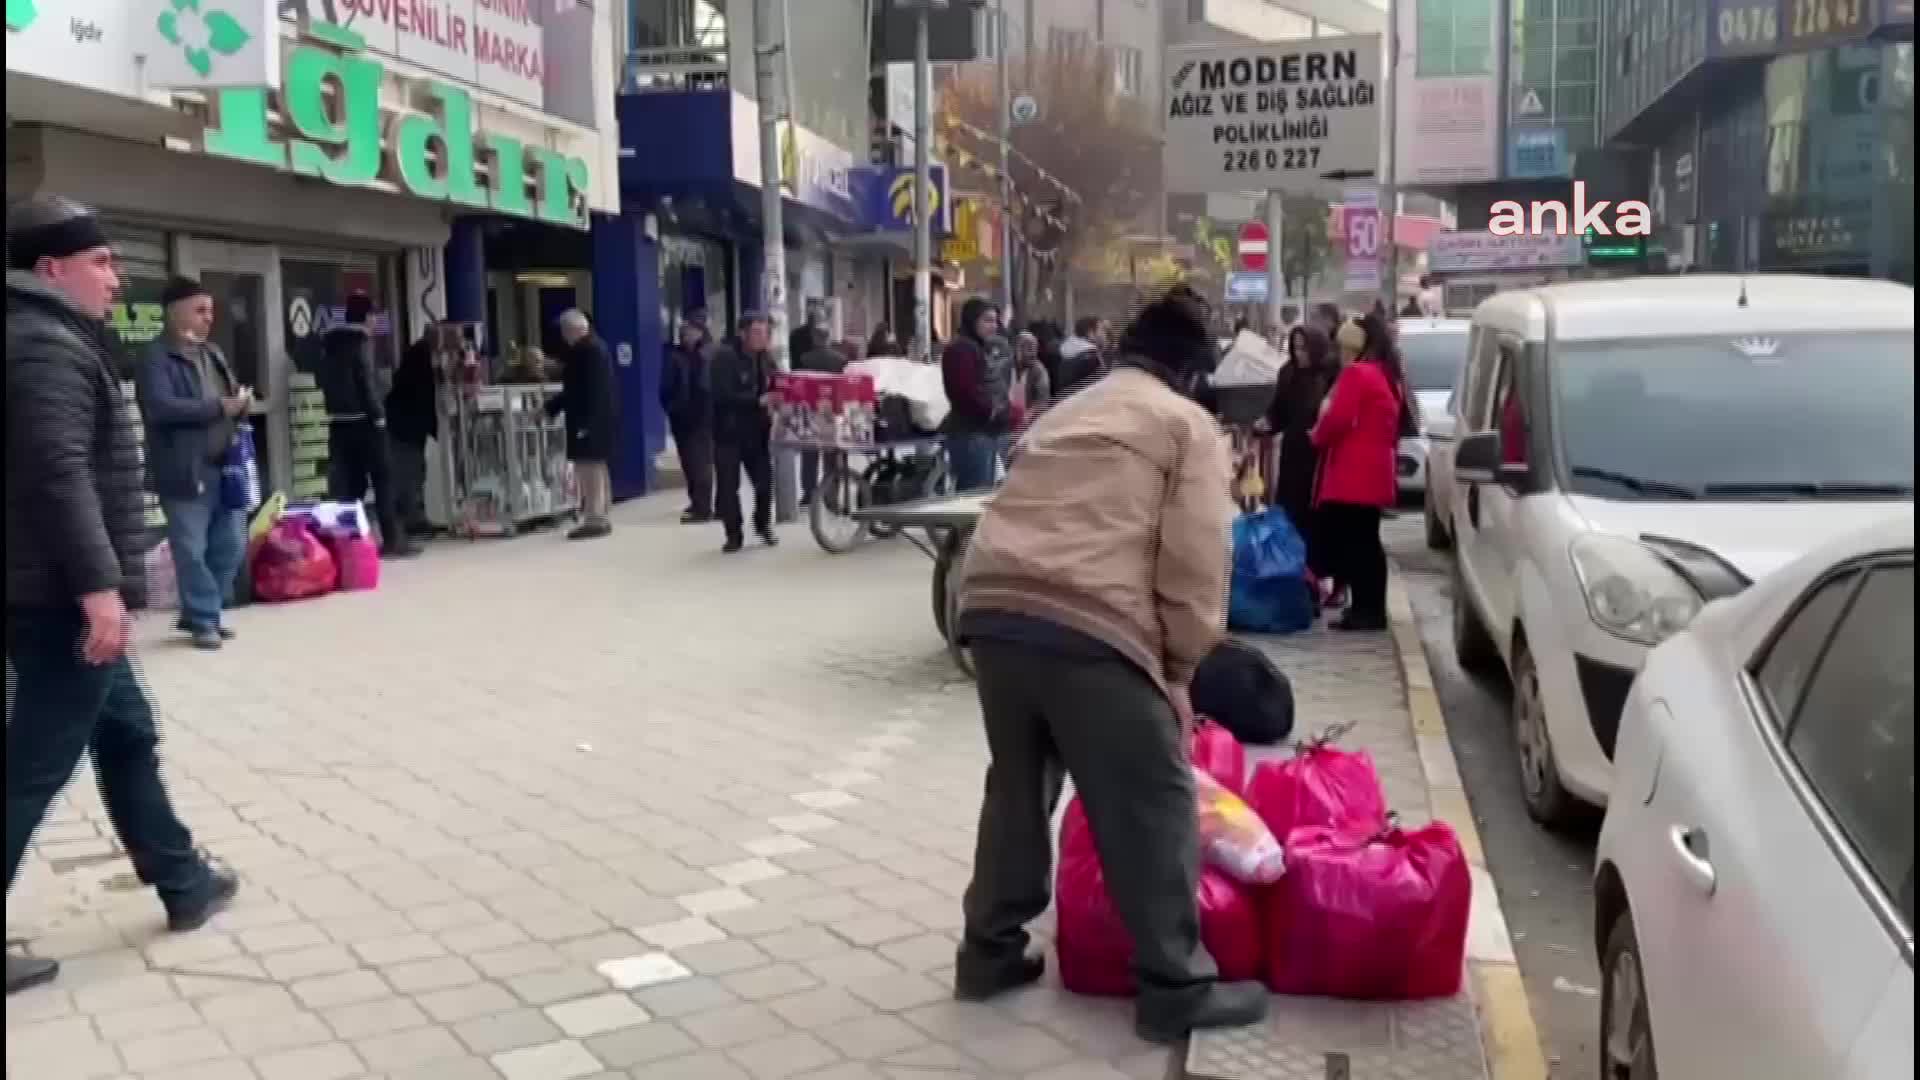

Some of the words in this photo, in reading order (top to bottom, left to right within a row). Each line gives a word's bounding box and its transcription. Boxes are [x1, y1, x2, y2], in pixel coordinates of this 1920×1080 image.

[473, 24, 544, 80] MARKA
[1199, 50, 1356, 90] MODERN
[1169, 91, 1214, 118] AĞIZ
[1221, 91, 1248, 114] VE
[1256, 86, 1289, 115] DİŞ
[1296, 80, 1374, 110] SAĞLIĞI
[1213, 114, 1329, 144] POLİKLİNİĞİ
